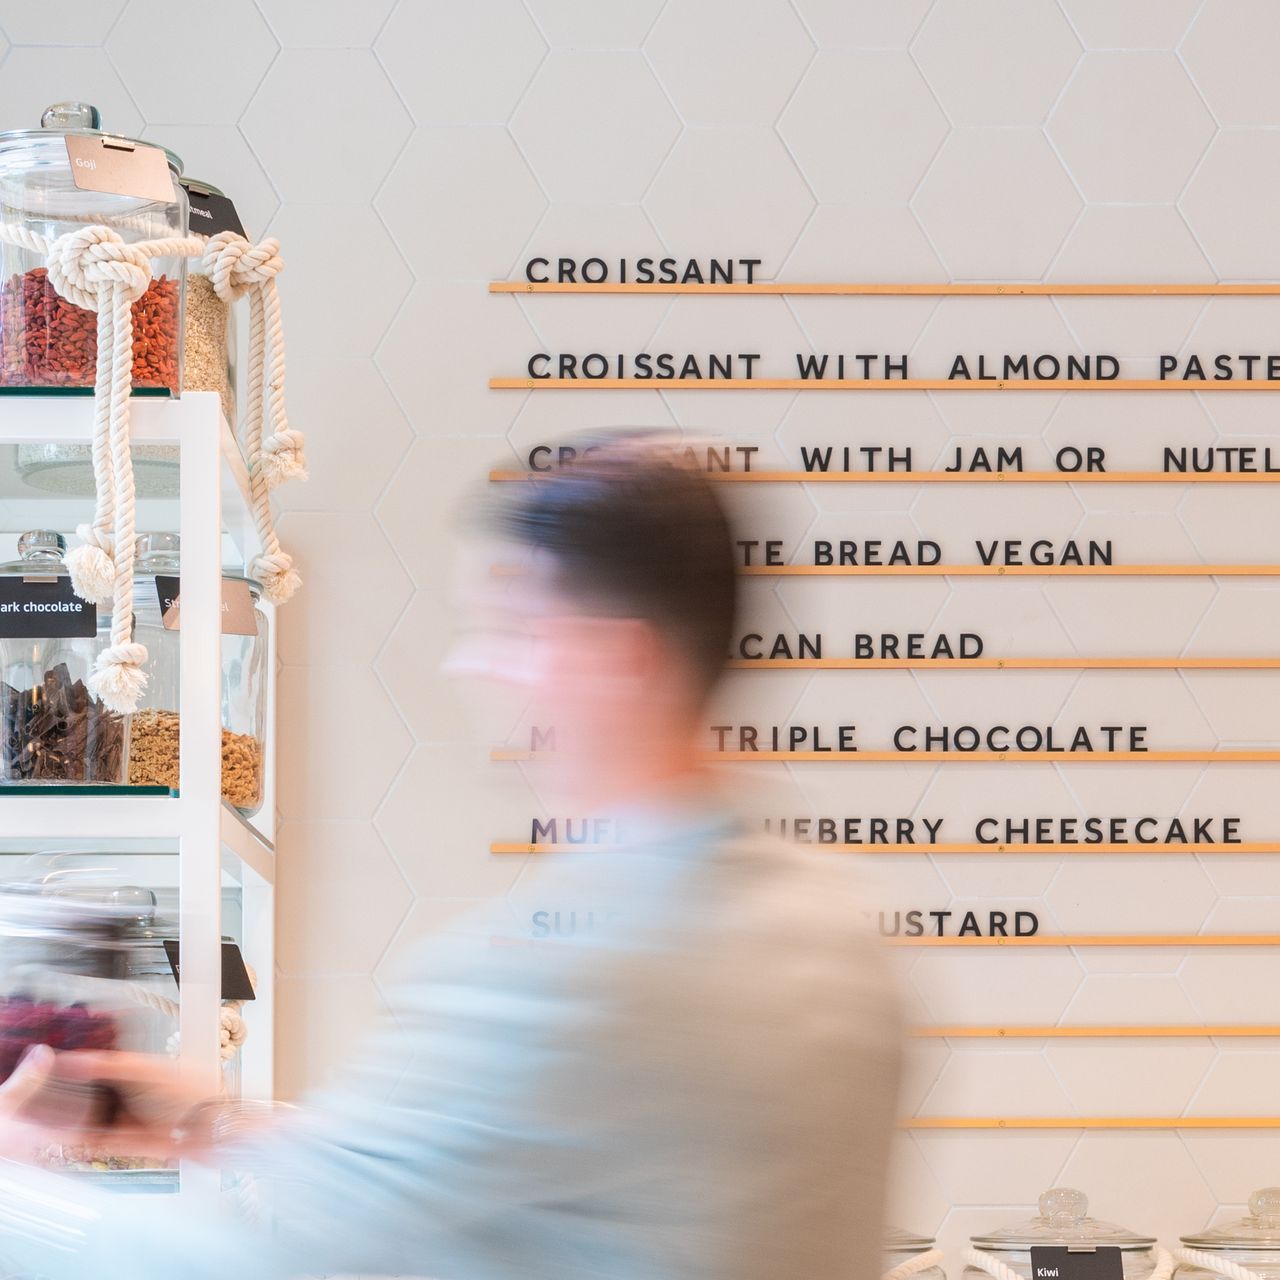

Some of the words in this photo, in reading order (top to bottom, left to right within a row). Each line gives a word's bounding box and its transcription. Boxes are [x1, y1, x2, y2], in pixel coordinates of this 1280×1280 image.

[75, 158, 97, 170] Goji
[525, 257, 762, 285] CROISSANT
[527, 353, 761, 380] CROISSANT
[796, 353, 909, 380] WITH
[947, 354, 1120, 381] ALMOND
[800, 446, 913, 473] WITH
[944, 446, 1024, 473] JAM
[1055, 446, 1107, 473] OR
[814, 540, 942, 566] BREAD
[975, 539, 1113, 566] VEGAN
[23, 601, 83, 613] chocolate
[738, 633, 823, 660] CAN
[854, 633, 985, 660] BREAD
[710, 725, 858, 752] TRIPLE
[893, 725, 1149, 752] CHOCOLATE
[765, 818, 944, 845] UEBERRY
[975, 817, 1242, 844] CHEESECAKE
[878, 910, 1039, 937] USTARD
[1036, 1267, 1059, 1278] Kiwi
